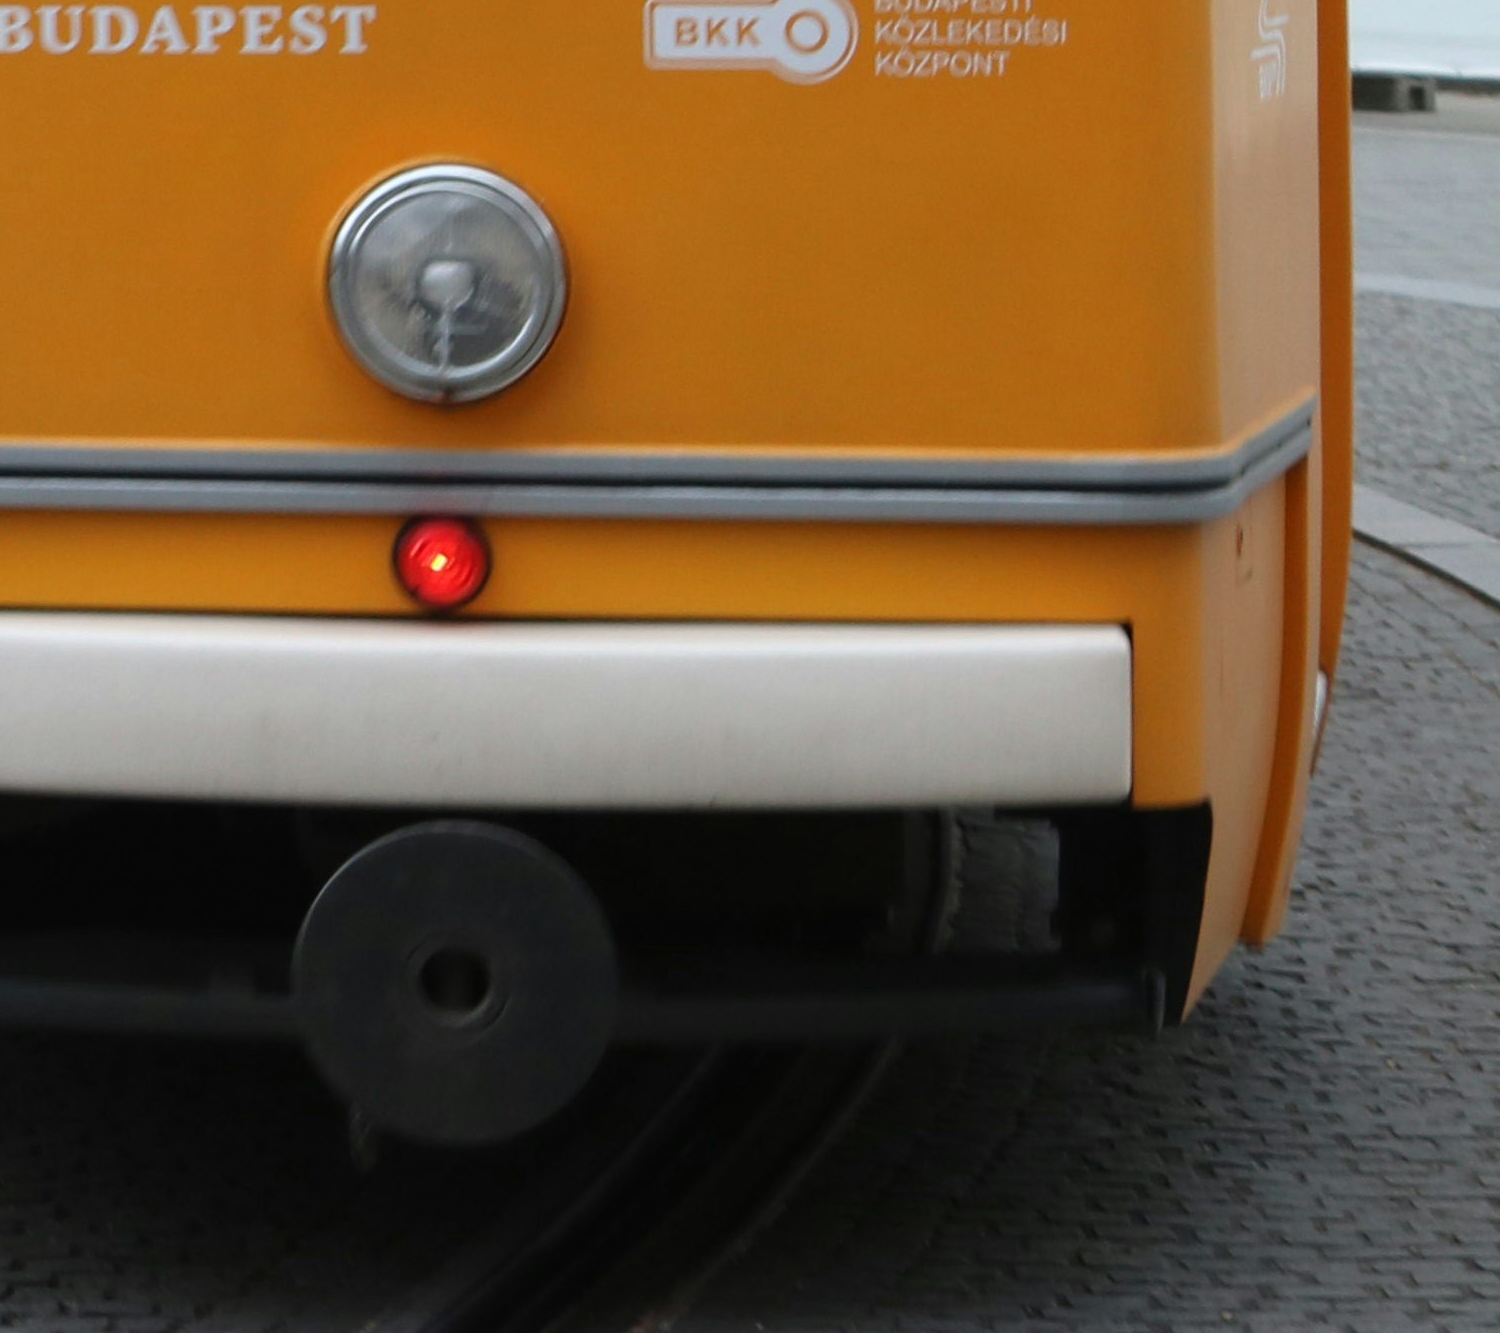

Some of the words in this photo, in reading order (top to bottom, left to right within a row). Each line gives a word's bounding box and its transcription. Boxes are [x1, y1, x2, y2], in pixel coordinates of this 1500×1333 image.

[674, 18, 762, 46] BKK
[874, 13, 1068, 46] KÖZLEKEDÉSI
[874, 46, 1011, 78] KÖZPONT
